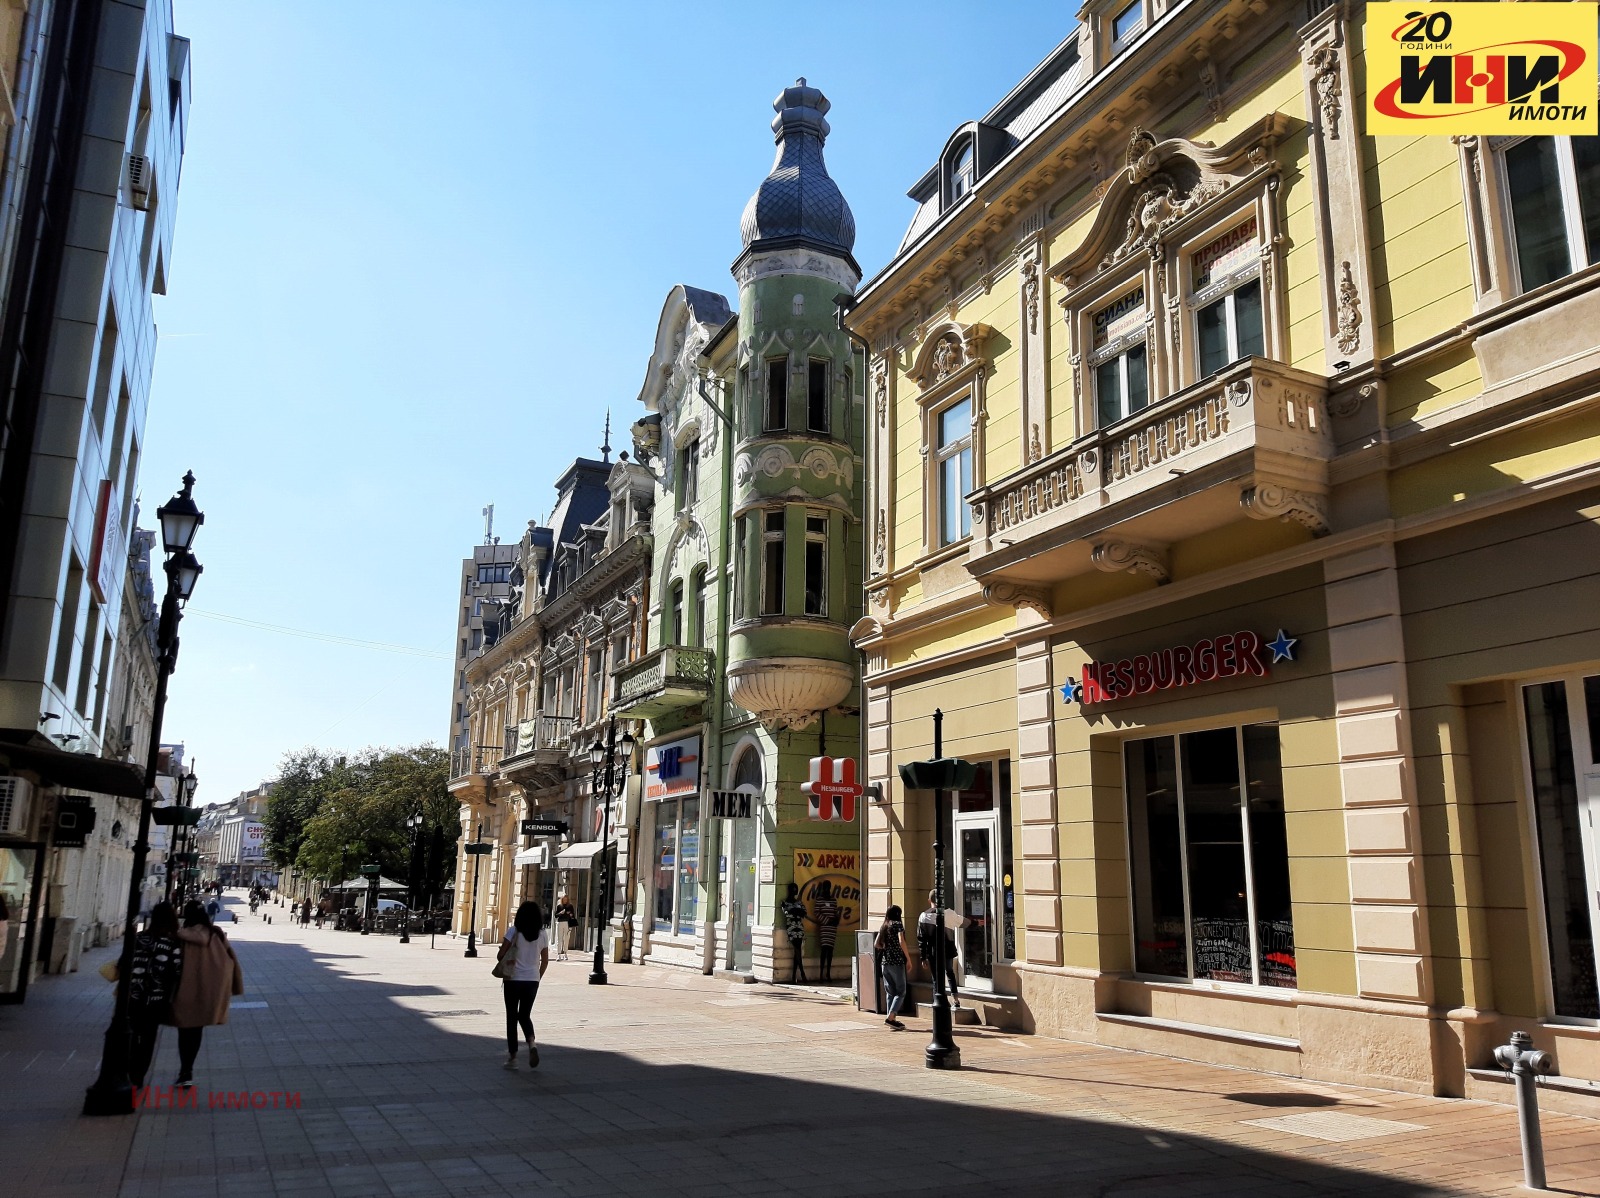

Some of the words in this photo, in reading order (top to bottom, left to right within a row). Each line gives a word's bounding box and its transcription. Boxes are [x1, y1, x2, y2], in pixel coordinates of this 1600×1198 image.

[1095, 288, 1144, 326] СИАНА
[1081, 630, 1266, 704] HESBURGER
[820, 784, 854, 794] HESBURGER
[817, 854, 854, 870] ДРЕХИ
